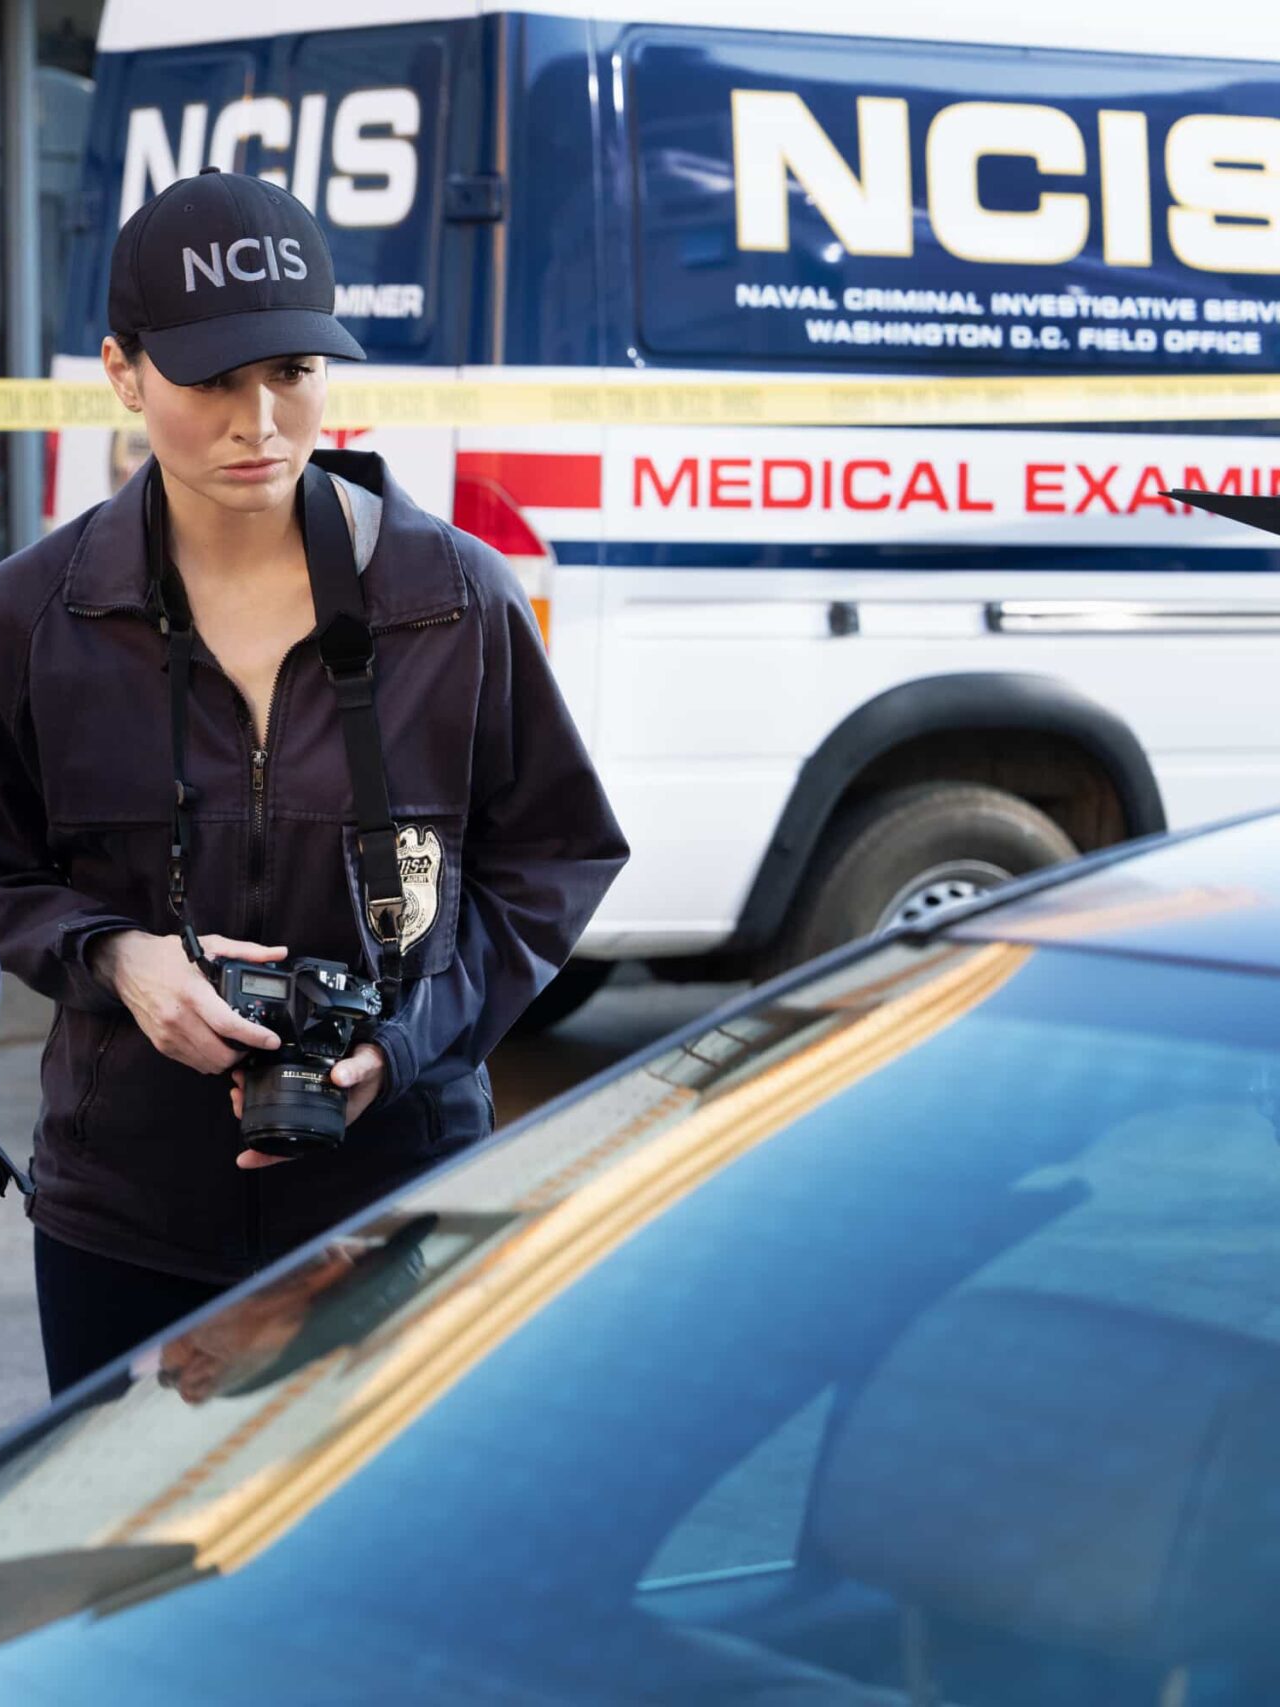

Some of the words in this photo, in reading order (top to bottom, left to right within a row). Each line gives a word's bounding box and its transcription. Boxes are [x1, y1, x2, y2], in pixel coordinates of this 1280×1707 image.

[119, 87, 421, 228] NCIS
[731, 88, 1280, 274] NCIS
[182, 235, 308, 292] NCIS
[334, 283, 425, 319] MINER
[735, 284, 838, 310] NAVAL
[843, 287, 985, 315] CRIMINAL
[990, 292, 1198, 322] INVESTIGATIVE
[805, 318, 1003, 349] WASHINGTON
[1010, 325, 1070, 350] D.C.
[1078, 326, 1158, 352] FIELD
[1163, 330, 1263, 355] OFFICE
[631, 457, 994, 512] MEDICAL
